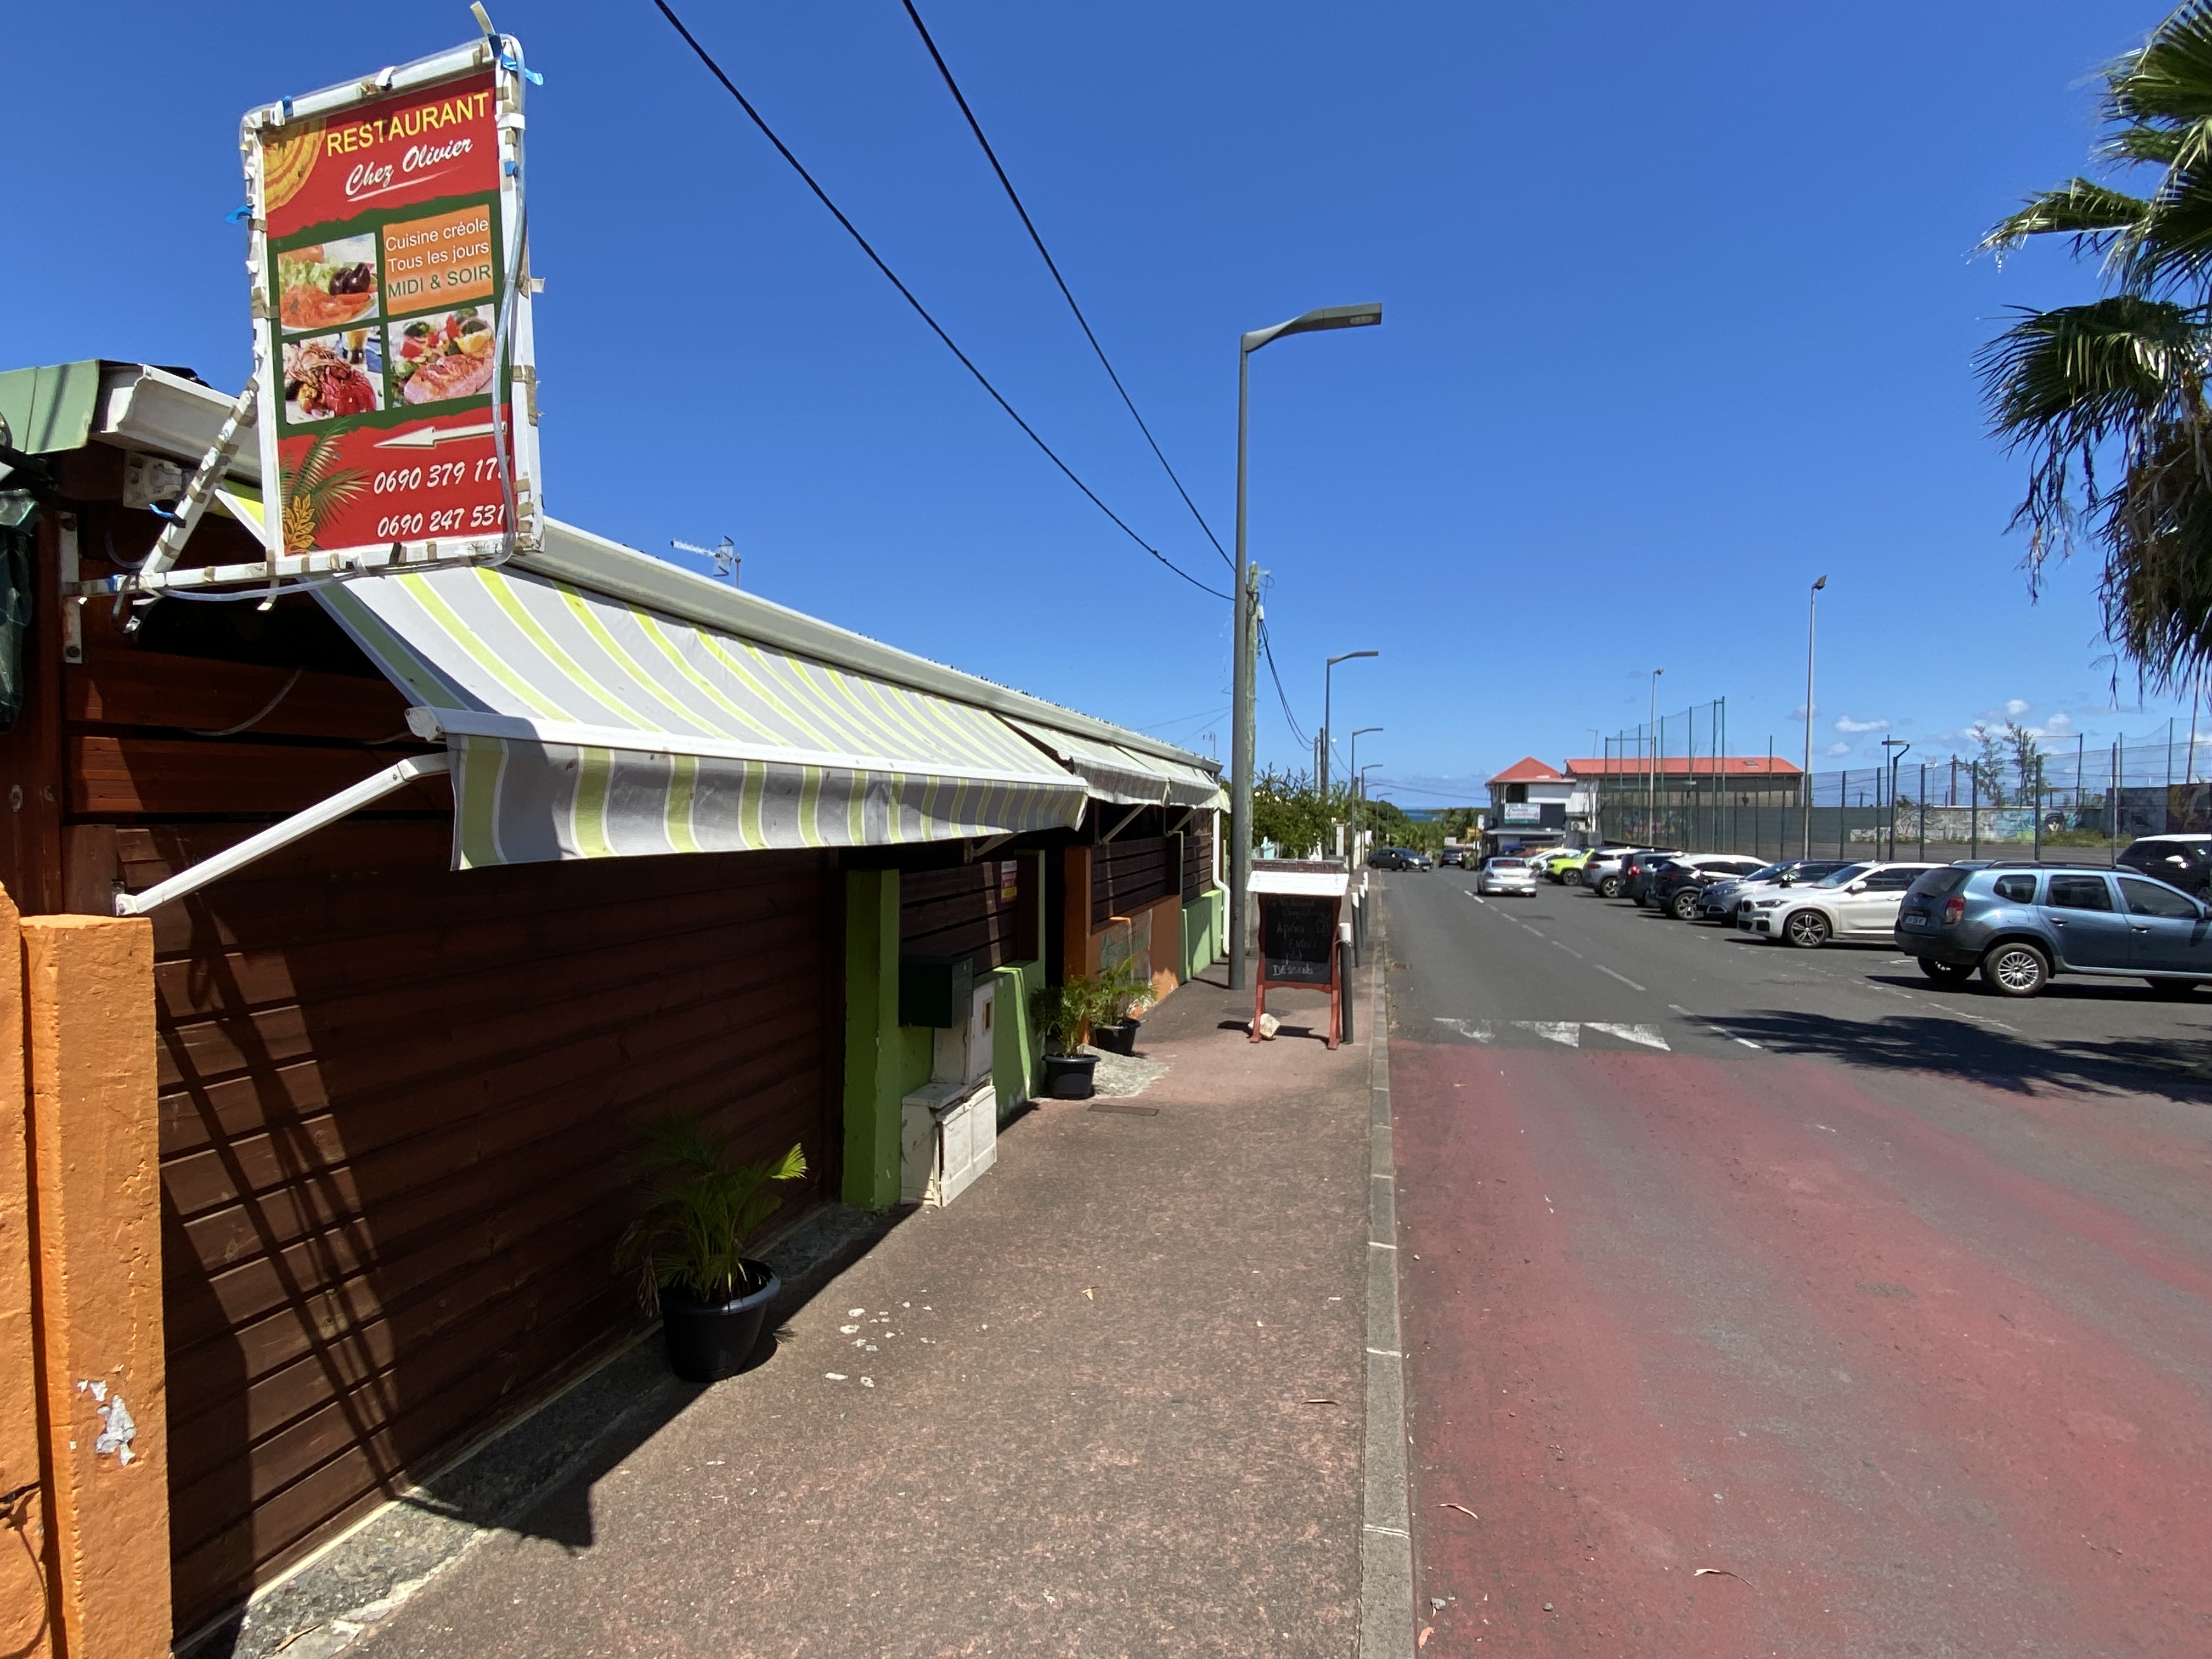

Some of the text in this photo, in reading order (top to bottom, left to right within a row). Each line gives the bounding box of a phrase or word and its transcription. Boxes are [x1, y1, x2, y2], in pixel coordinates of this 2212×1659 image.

[328, 92, 489, 156] RESTAURANT
[346, 138, 473, 195] Chez Olivier
[386, 218, 489, 251] Cuisine créole
[387, 241, 489, 272] Tous les jours
[388, 264, 492, 298] MIDI & SOIR
[374, 467, 422, 494] 0690
[427, 461, 465, 487] 379
[377, 504, 505, 537] 0690 247 531
